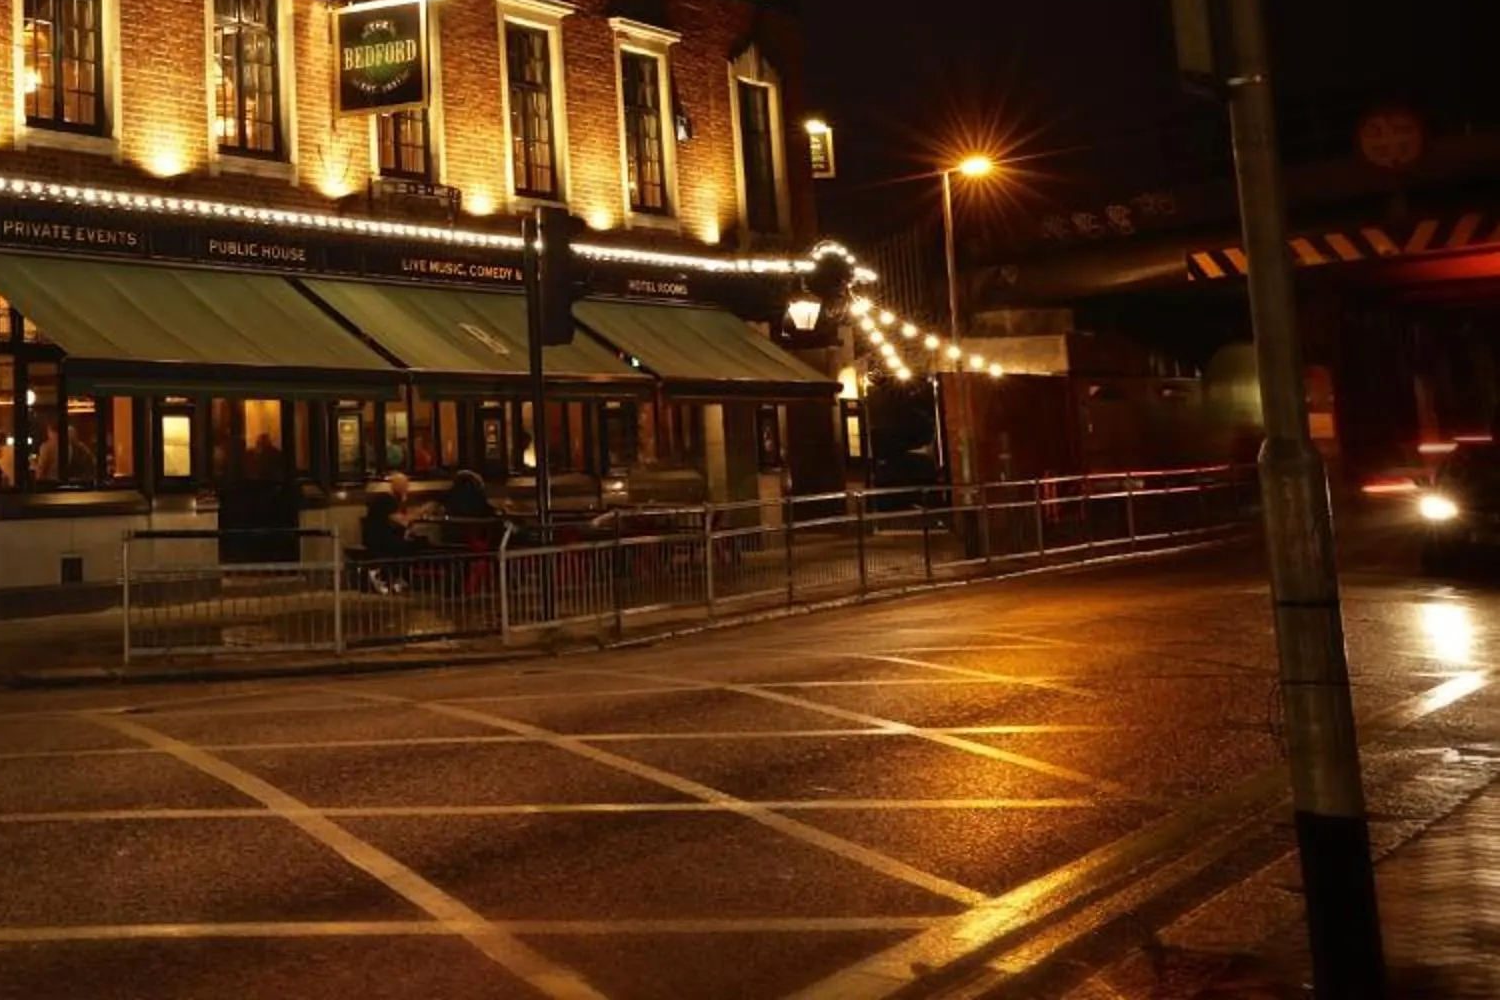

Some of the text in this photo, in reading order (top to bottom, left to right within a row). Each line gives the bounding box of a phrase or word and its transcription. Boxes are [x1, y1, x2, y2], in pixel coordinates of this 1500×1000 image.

[343, 39, 417, 71] BEDFORD
[3, 219, 137, 246] PRIVATE EVENTS
[209, 239, 306, 262] PUBLIC HOUSE
[402, 258, 427, 273] LIVE
[469, 264, 512, 281] COMEDY
